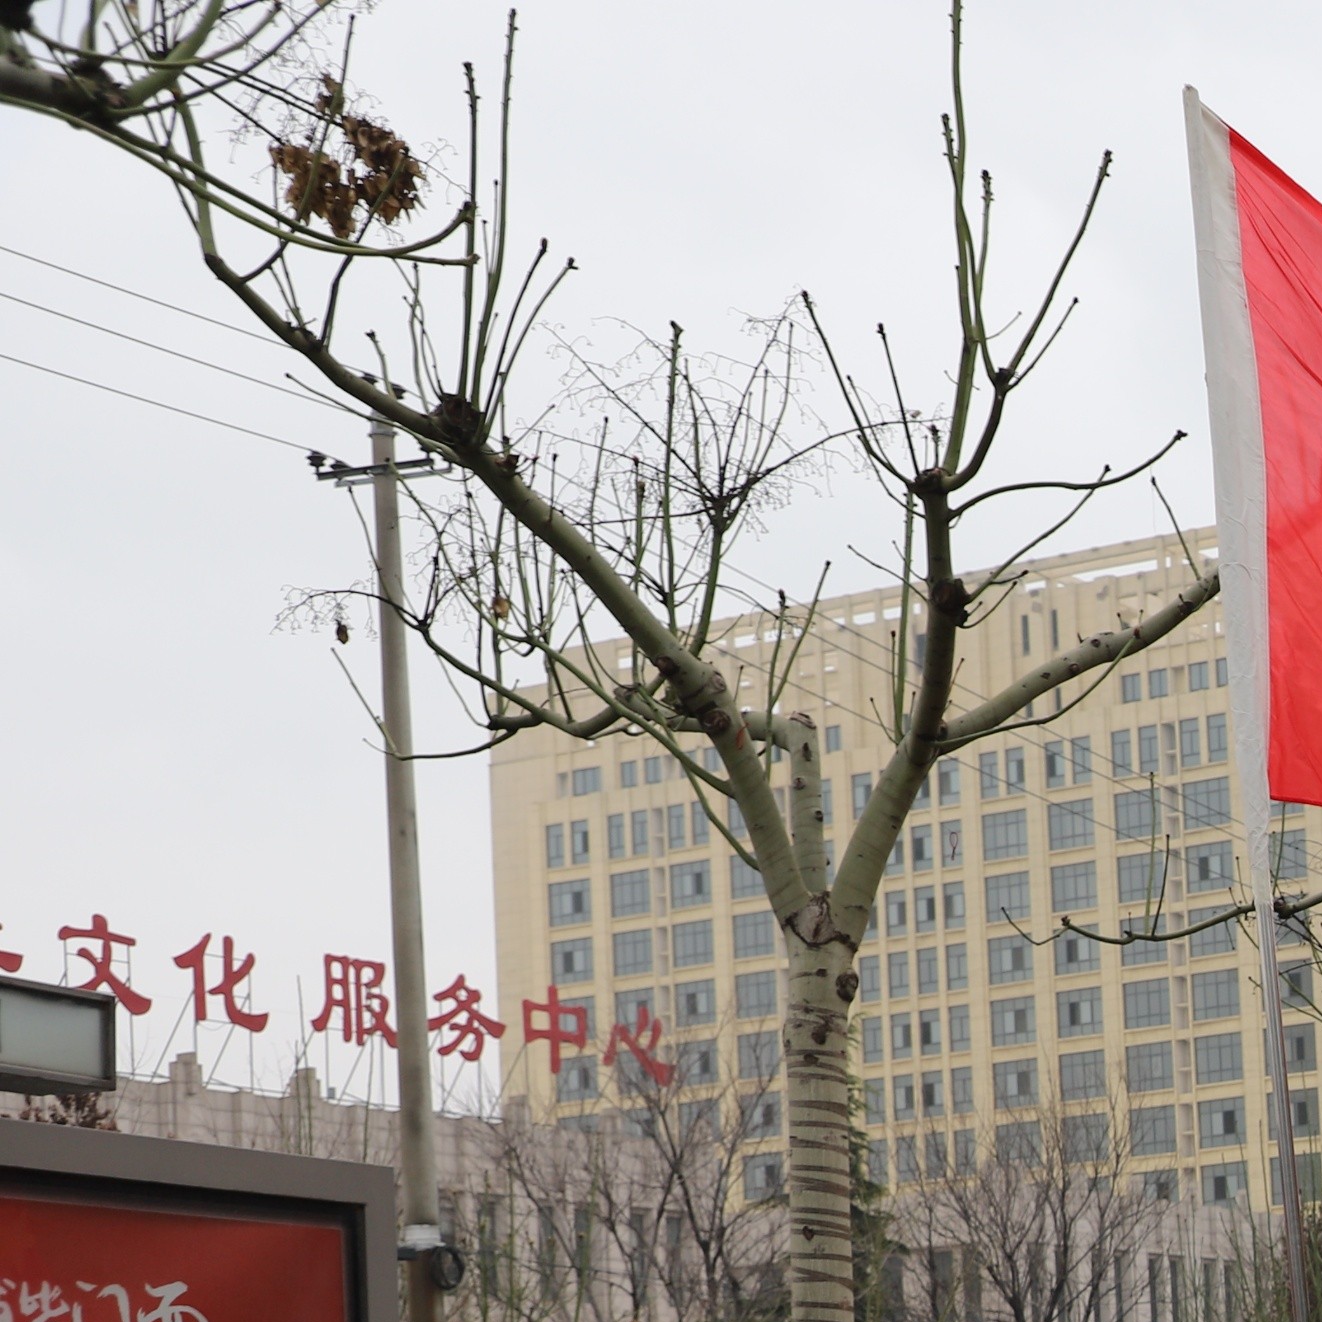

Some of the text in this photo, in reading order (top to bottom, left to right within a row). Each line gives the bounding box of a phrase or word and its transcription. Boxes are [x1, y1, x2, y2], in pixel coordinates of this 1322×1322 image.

[0, 913, 675, 1086] 文化服务中心
